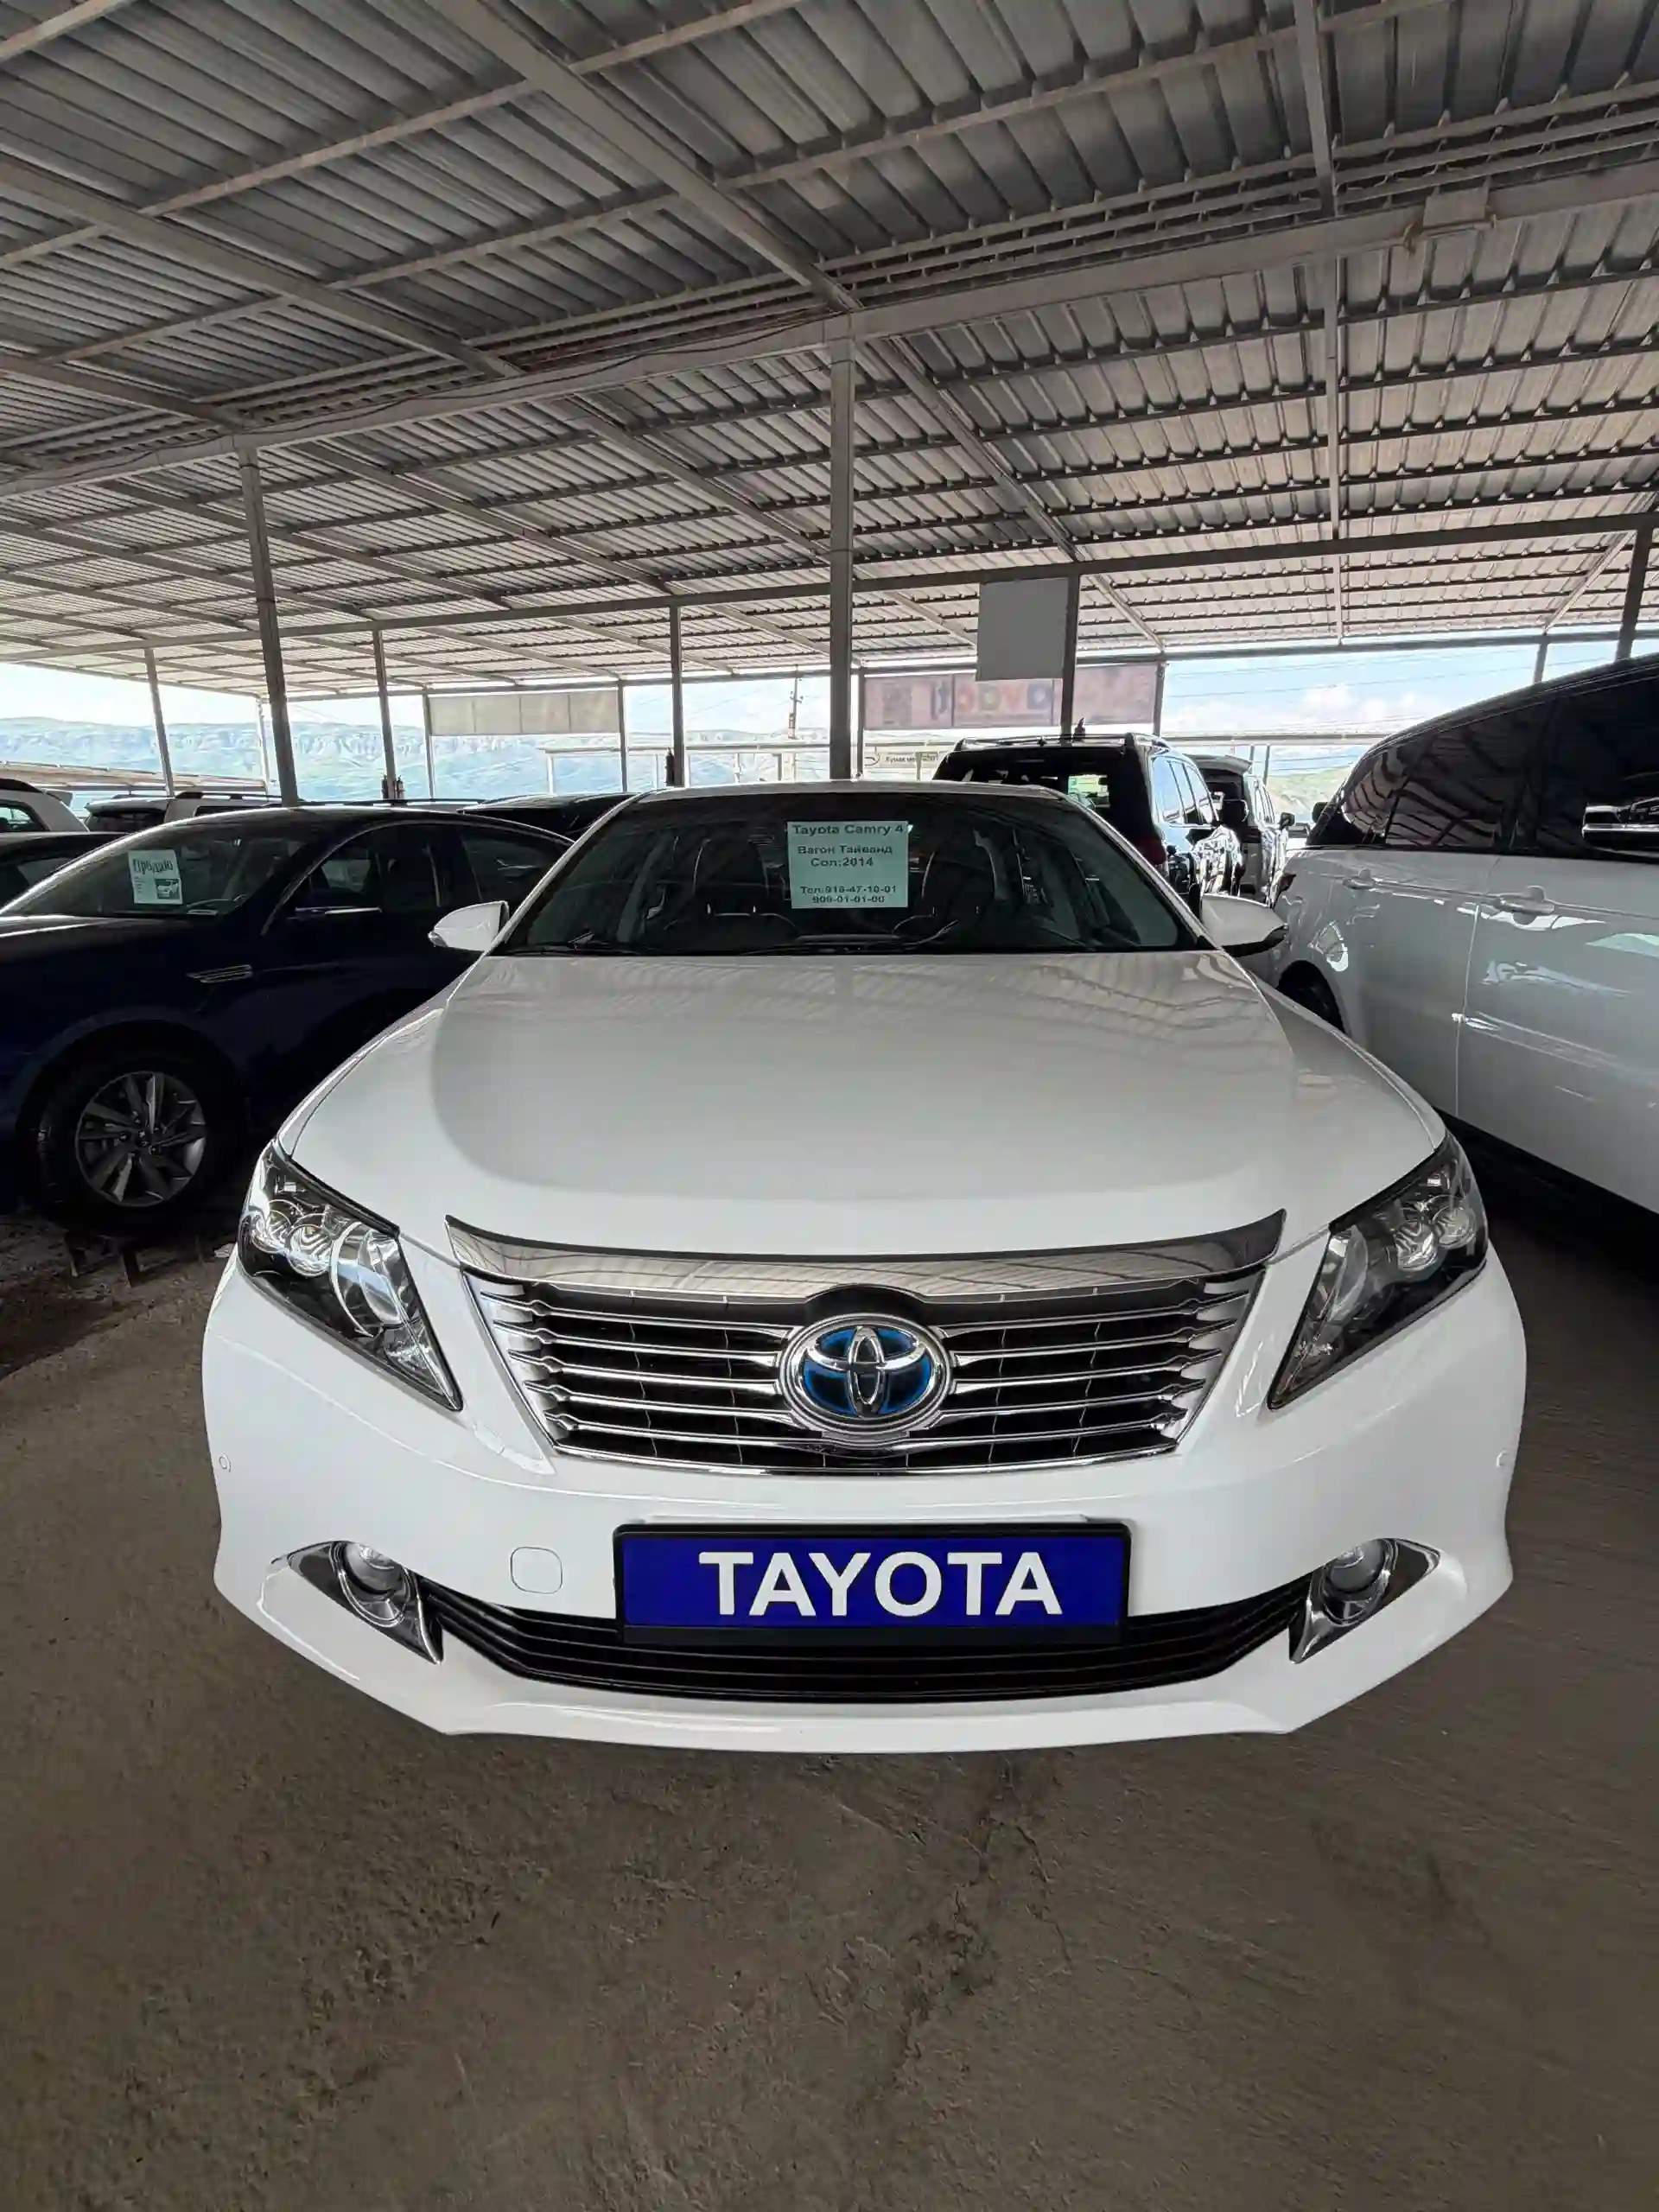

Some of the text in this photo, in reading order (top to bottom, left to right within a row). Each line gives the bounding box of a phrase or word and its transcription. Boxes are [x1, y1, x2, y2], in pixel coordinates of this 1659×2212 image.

[793, 824, 840, 836] Tayota
[844, 823, 891, 836] Camry
[698, 1551, 1064, 1617] TAYOTA
